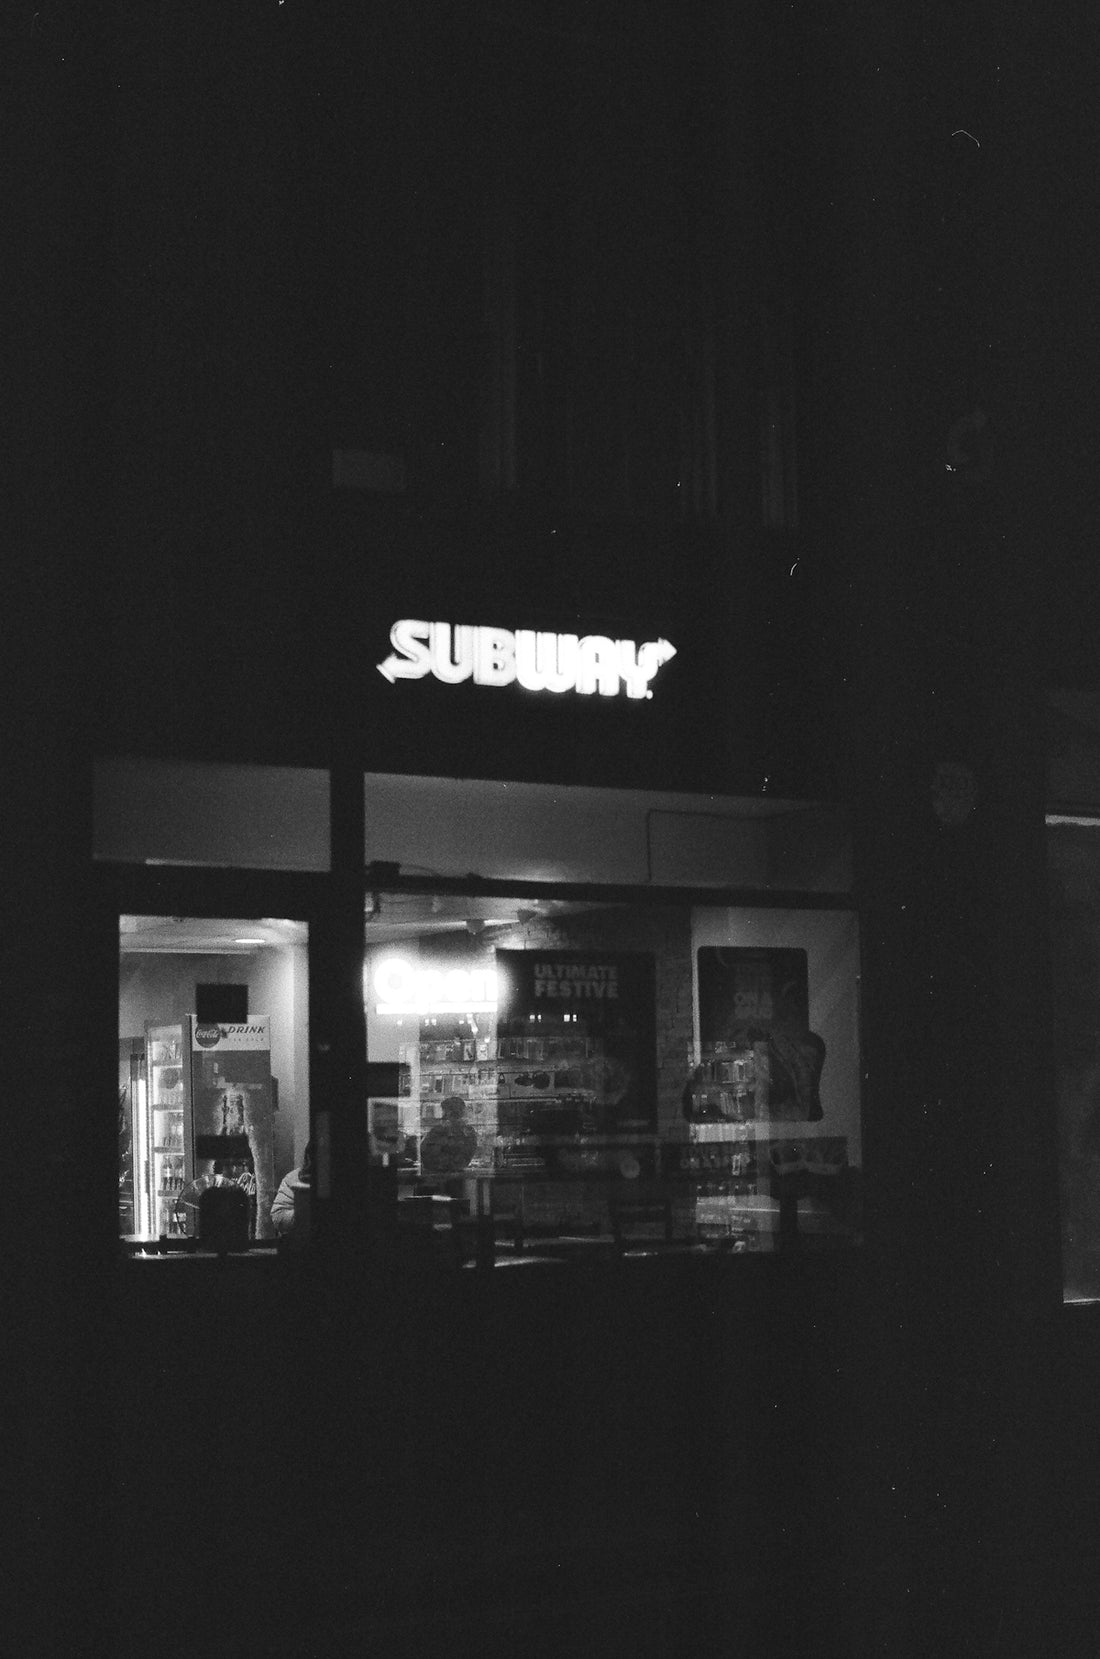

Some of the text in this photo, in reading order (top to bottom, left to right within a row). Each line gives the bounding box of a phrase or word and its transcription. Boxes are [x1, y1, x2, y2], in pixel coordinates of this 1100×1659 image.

[377, 619, 677, 700] SUBWAY
[533, 964, 618, 980] ULTIMATE
[533, 980, 619, 999] FESTIVE
[228, 1025, 266, 1034] DRINK
